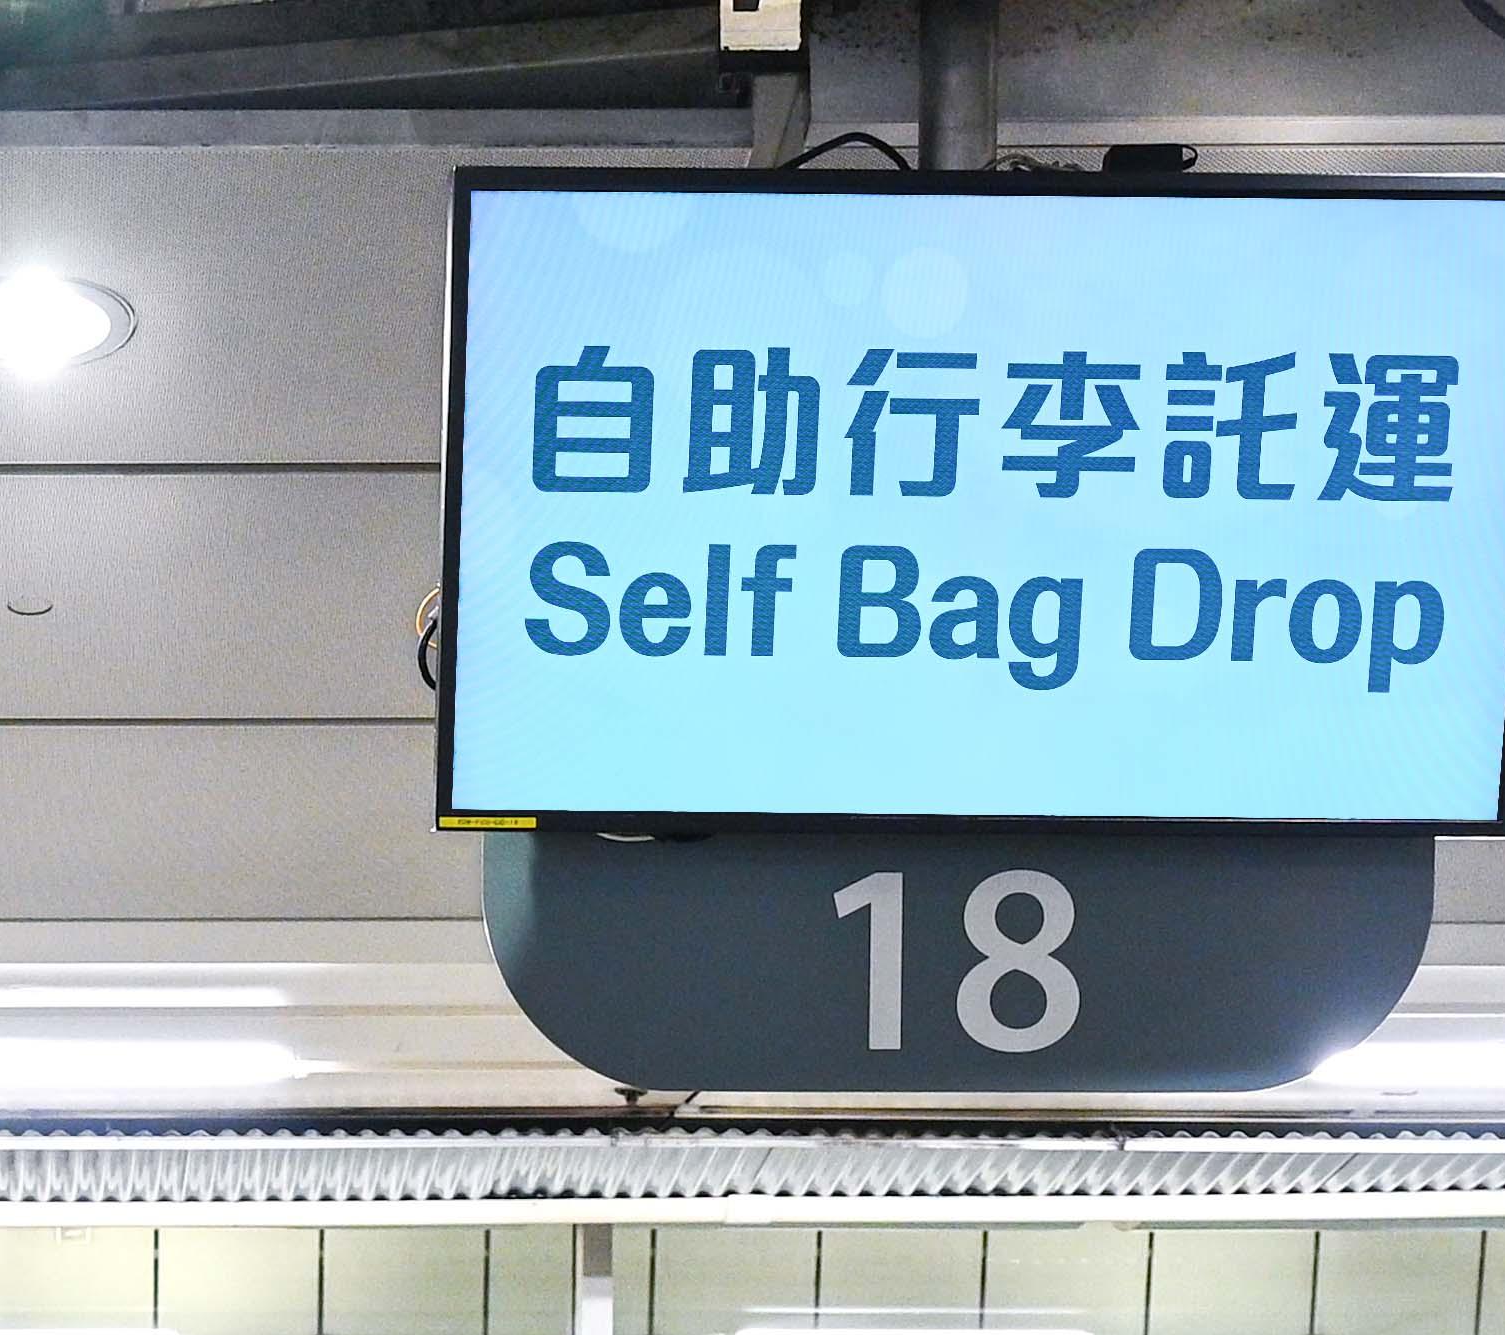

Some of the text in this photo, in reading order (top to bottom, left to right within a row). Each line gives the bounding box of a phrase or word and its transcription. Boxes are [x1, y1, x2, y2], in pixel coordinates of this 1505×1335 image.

[531, 345, 1460, 502] 自助行李託運
[524, 540, 1445, 694] Self Bag Drop
[833, 869, 1080, 1053] 18
